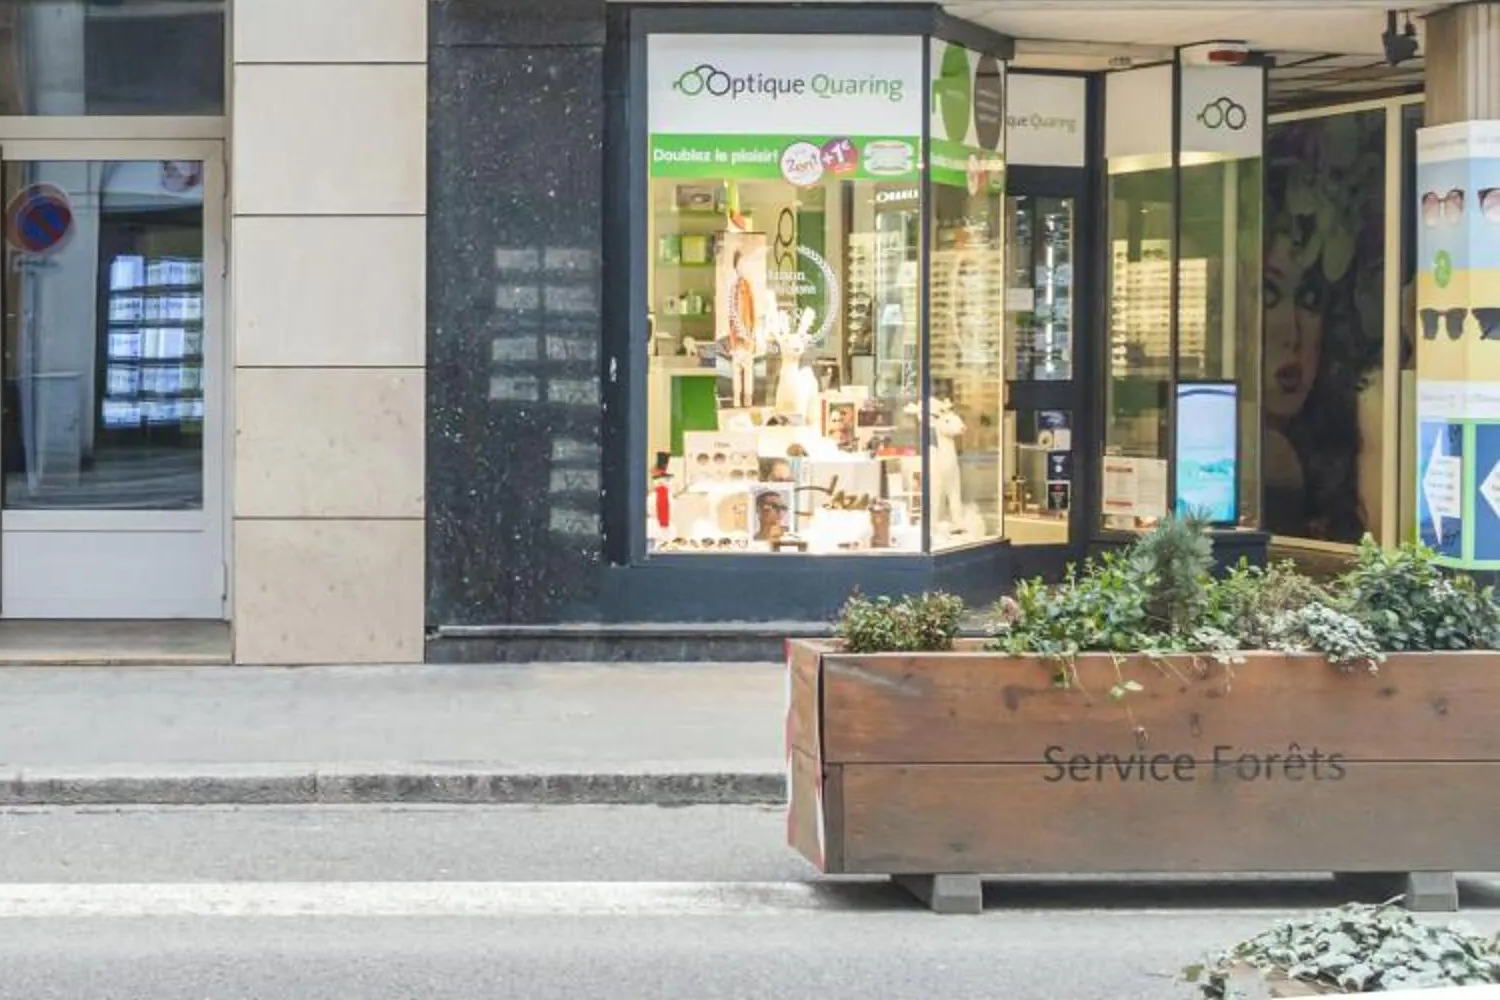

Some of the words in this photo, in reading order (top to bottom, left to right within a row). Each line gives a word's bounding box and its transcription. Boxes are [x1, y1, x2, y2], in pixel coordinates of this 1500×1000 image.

[706, 70, 805, 99] Optique
[810, 73, 904, 101] Quaring
[1043, 745, 1196, 783] Service
[1213, 742, 1347, 782] Forêts
